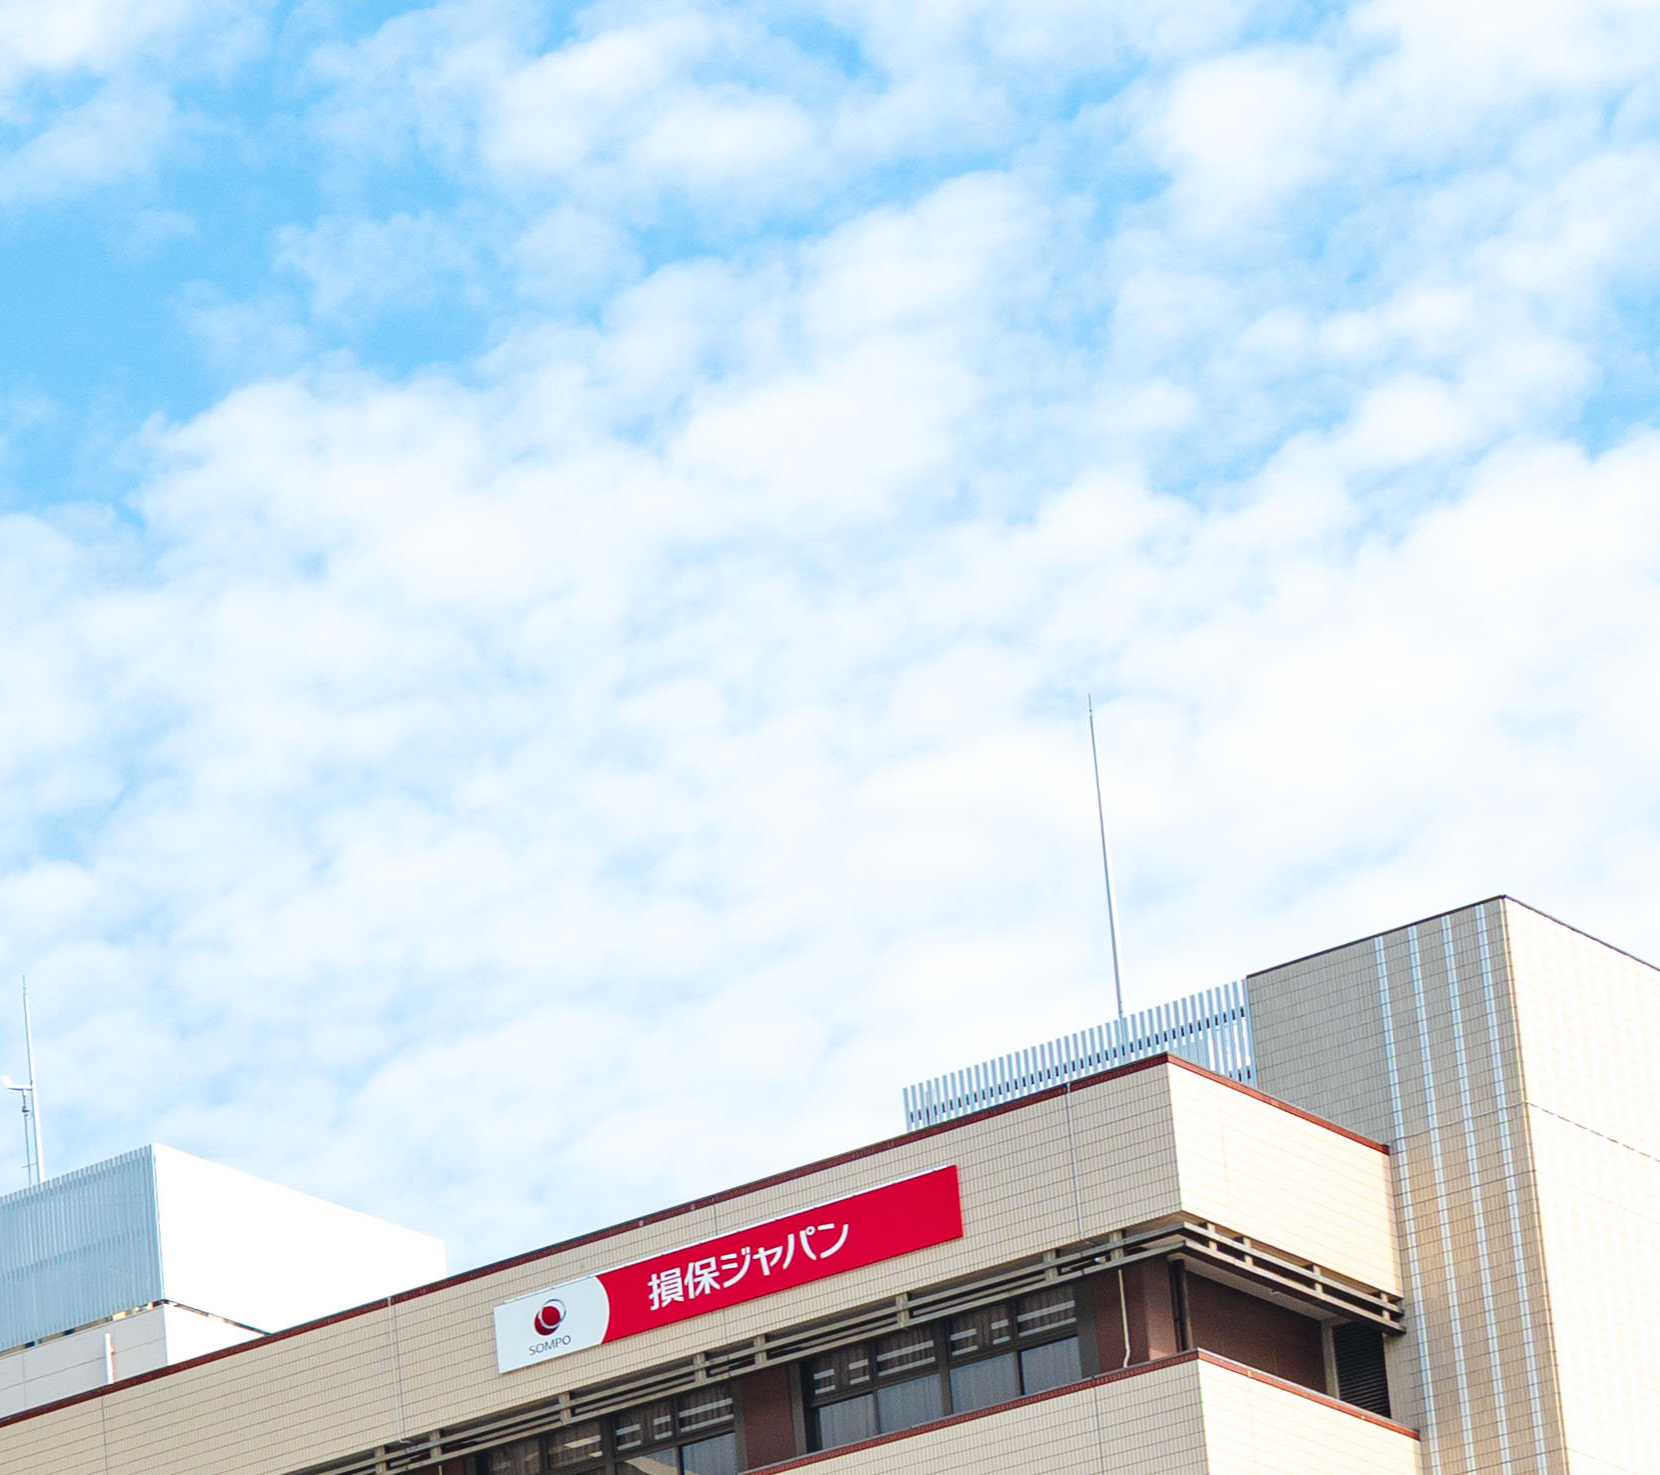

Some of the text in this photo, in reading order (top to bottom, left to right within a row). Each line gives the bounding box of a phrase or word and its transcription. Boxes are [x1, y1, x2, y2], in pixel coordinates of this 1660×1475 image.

[647, 1223, 849, 1311] 損保ジャパン
[528, 1335, 572, 1356] SOMPO
